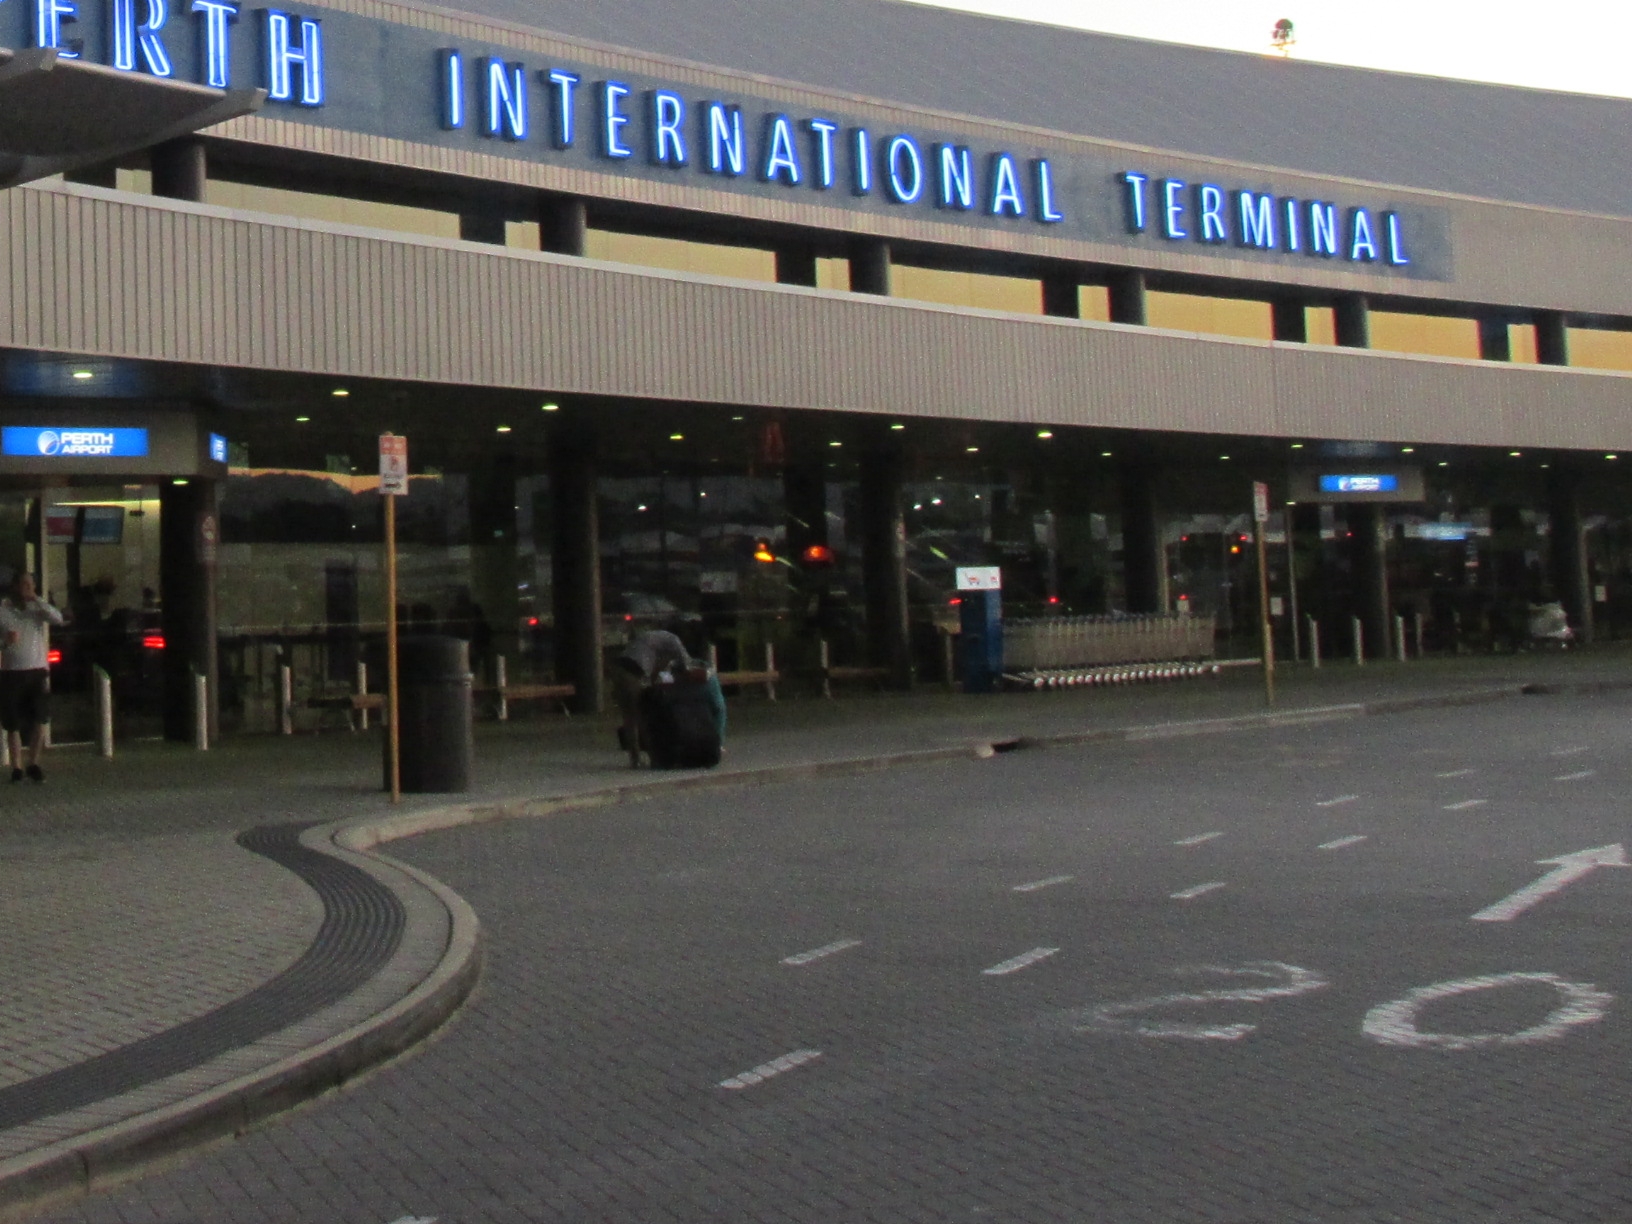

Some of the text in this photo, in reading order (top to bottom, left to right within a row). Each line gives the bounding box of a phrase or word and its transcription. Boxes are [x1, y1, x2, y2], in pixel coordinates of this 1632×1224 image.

[438, 47, 1065, 223] INTERNATIONAL
[1119, 170, 1412, 265] TERMINAL
[60, 431, 114, 445] PERTH
[61, 444, 113, 455] AIRPORT
